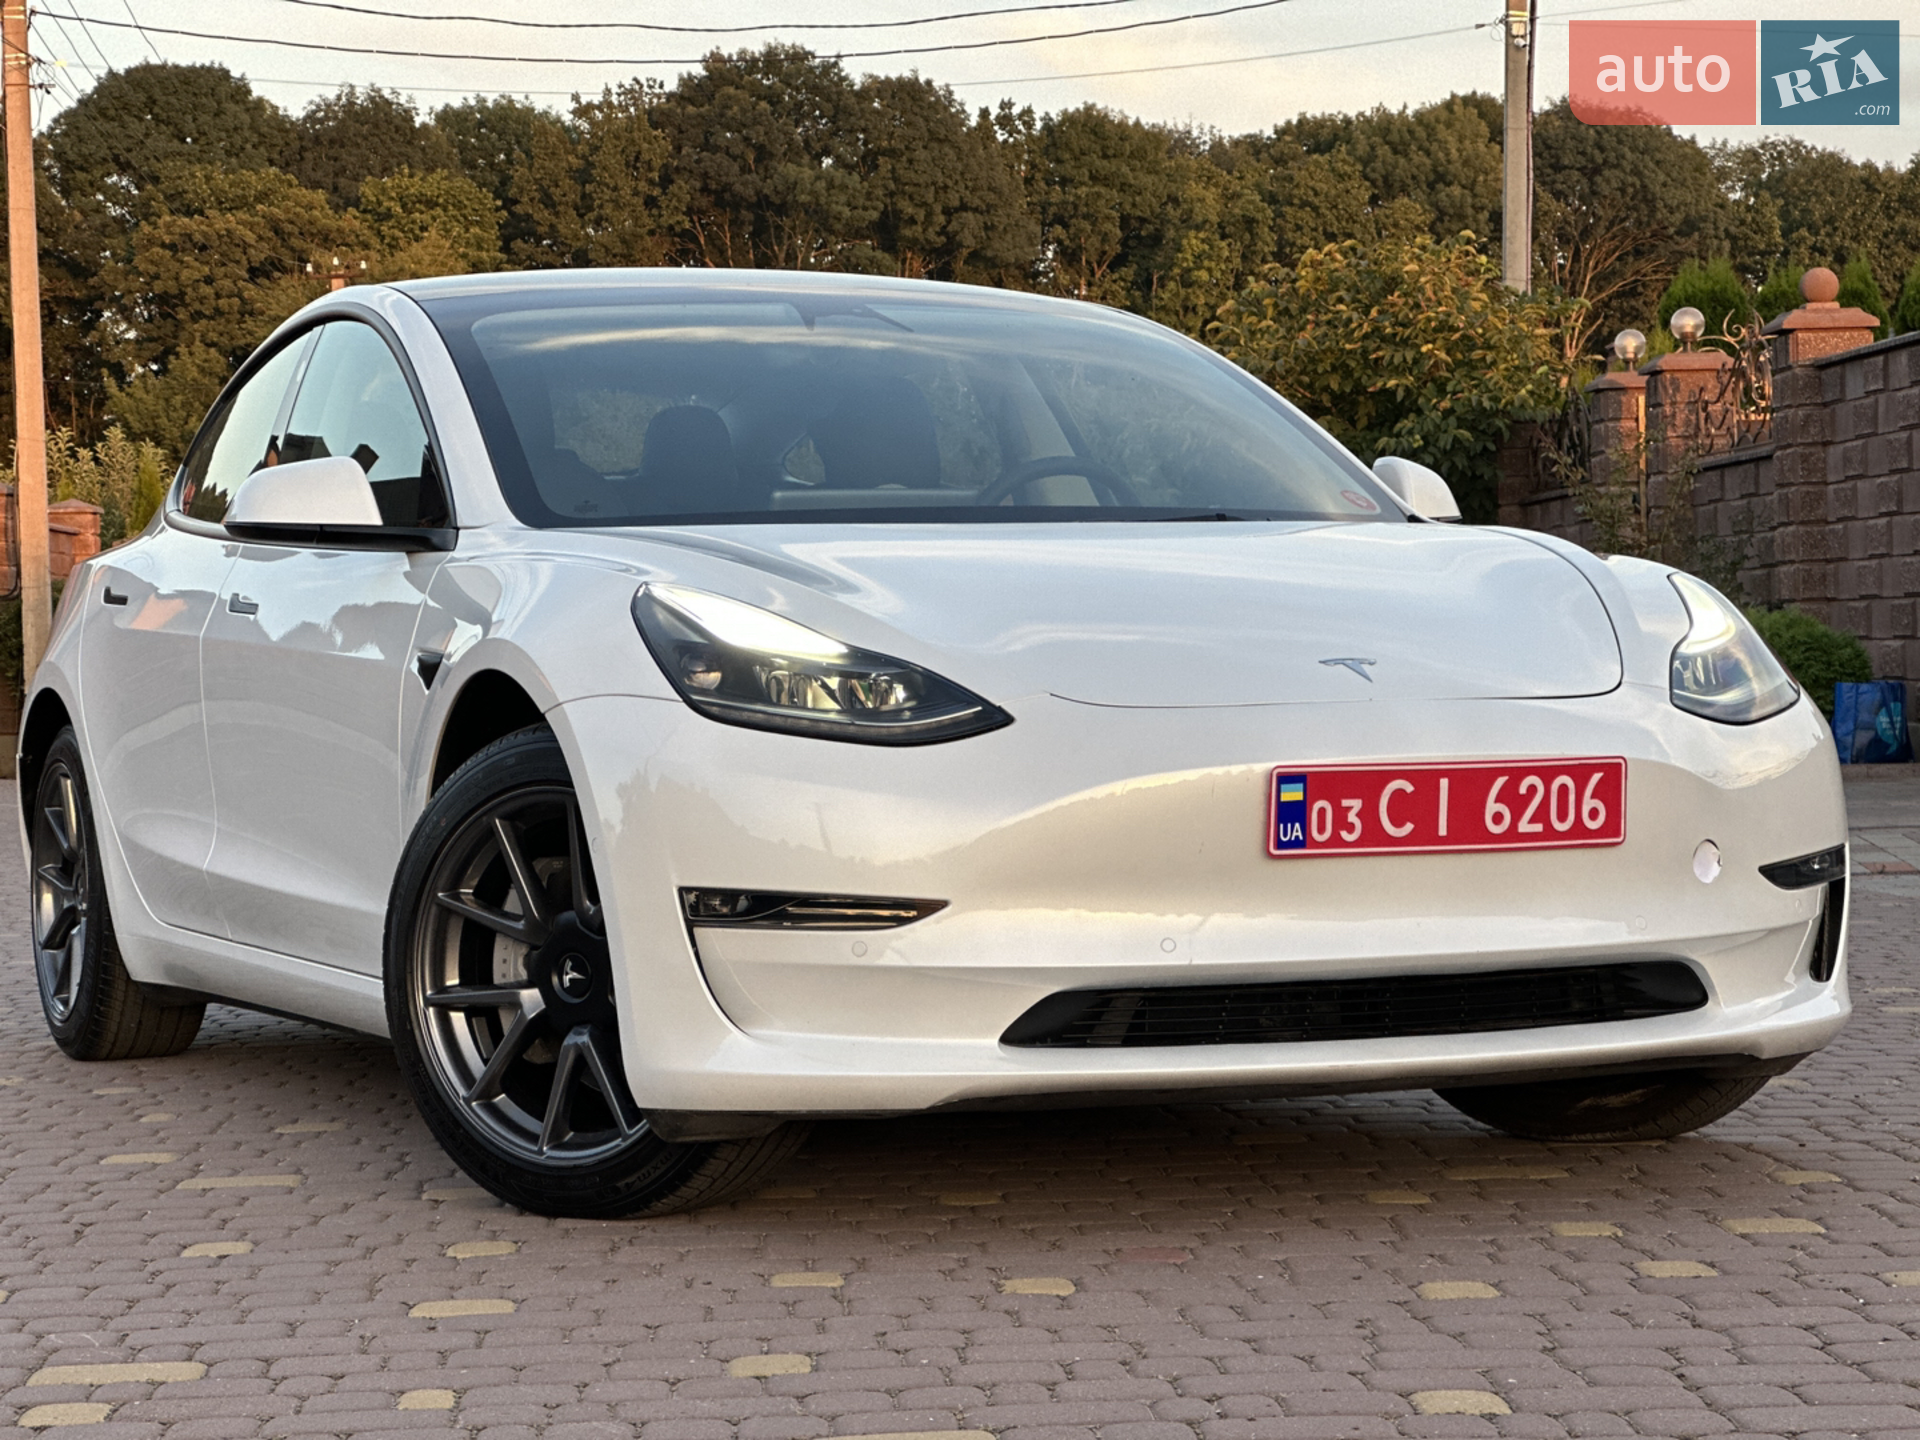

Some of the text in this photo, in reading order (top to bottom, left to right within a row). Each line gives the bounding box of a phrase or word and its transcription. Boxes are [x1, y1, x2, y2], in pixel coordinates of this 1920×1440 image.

[1310, 798, 1363, 843] 03
[1484, 772, 1607, 835] 6206
[1279, 822, 1303, 842] UA
